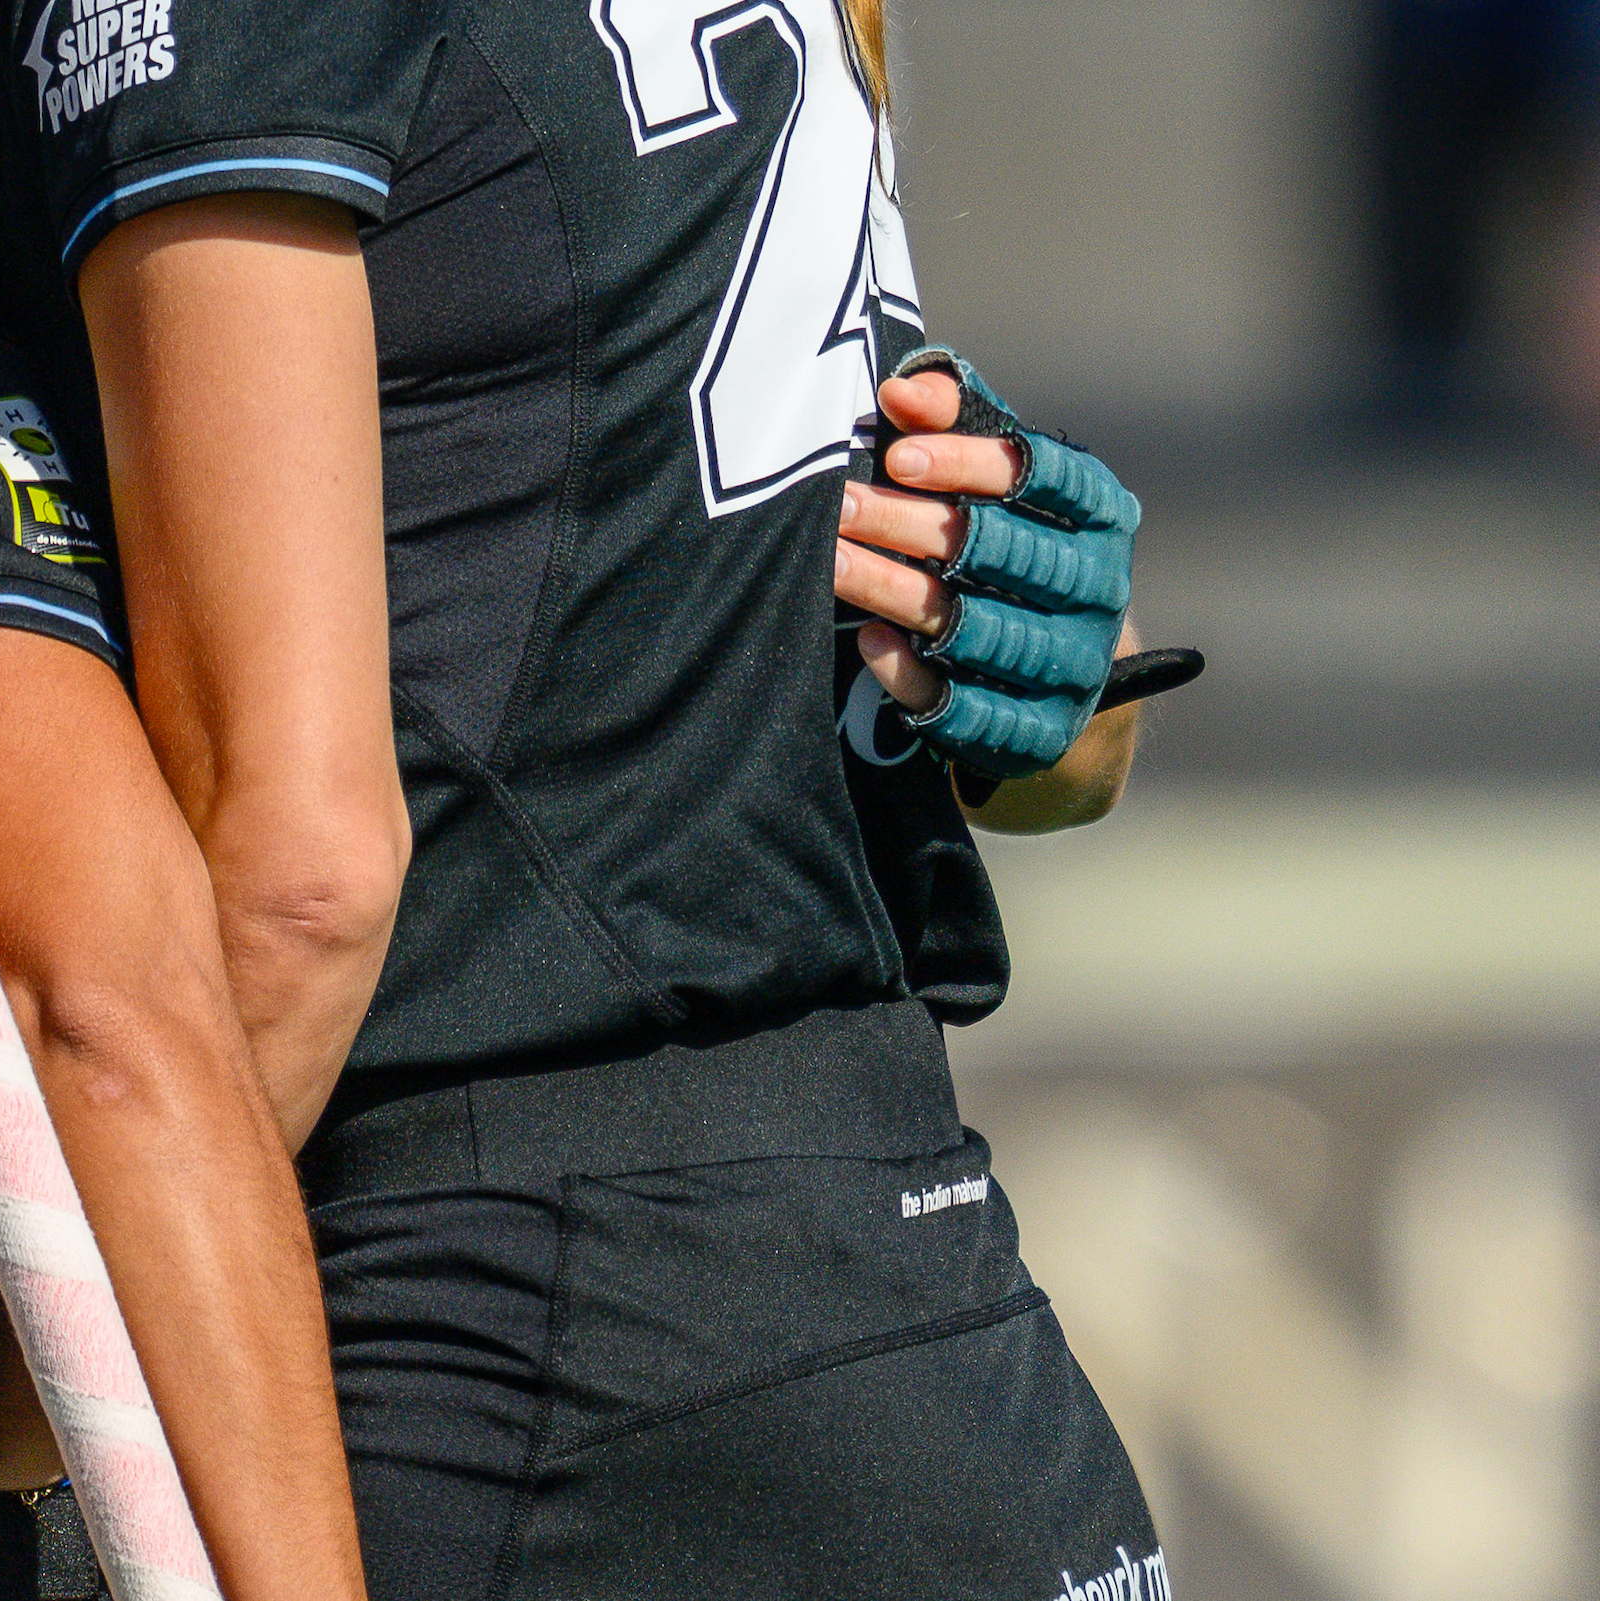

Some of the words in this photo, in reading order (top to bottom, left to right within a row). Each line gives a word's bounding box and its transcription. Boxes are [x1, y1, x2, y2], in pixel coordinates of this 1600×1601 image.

[46, 33, 176, 135] POWERS
[901, 1191, 921, 1219] the
[921, 1183, 952, 1214] indian
